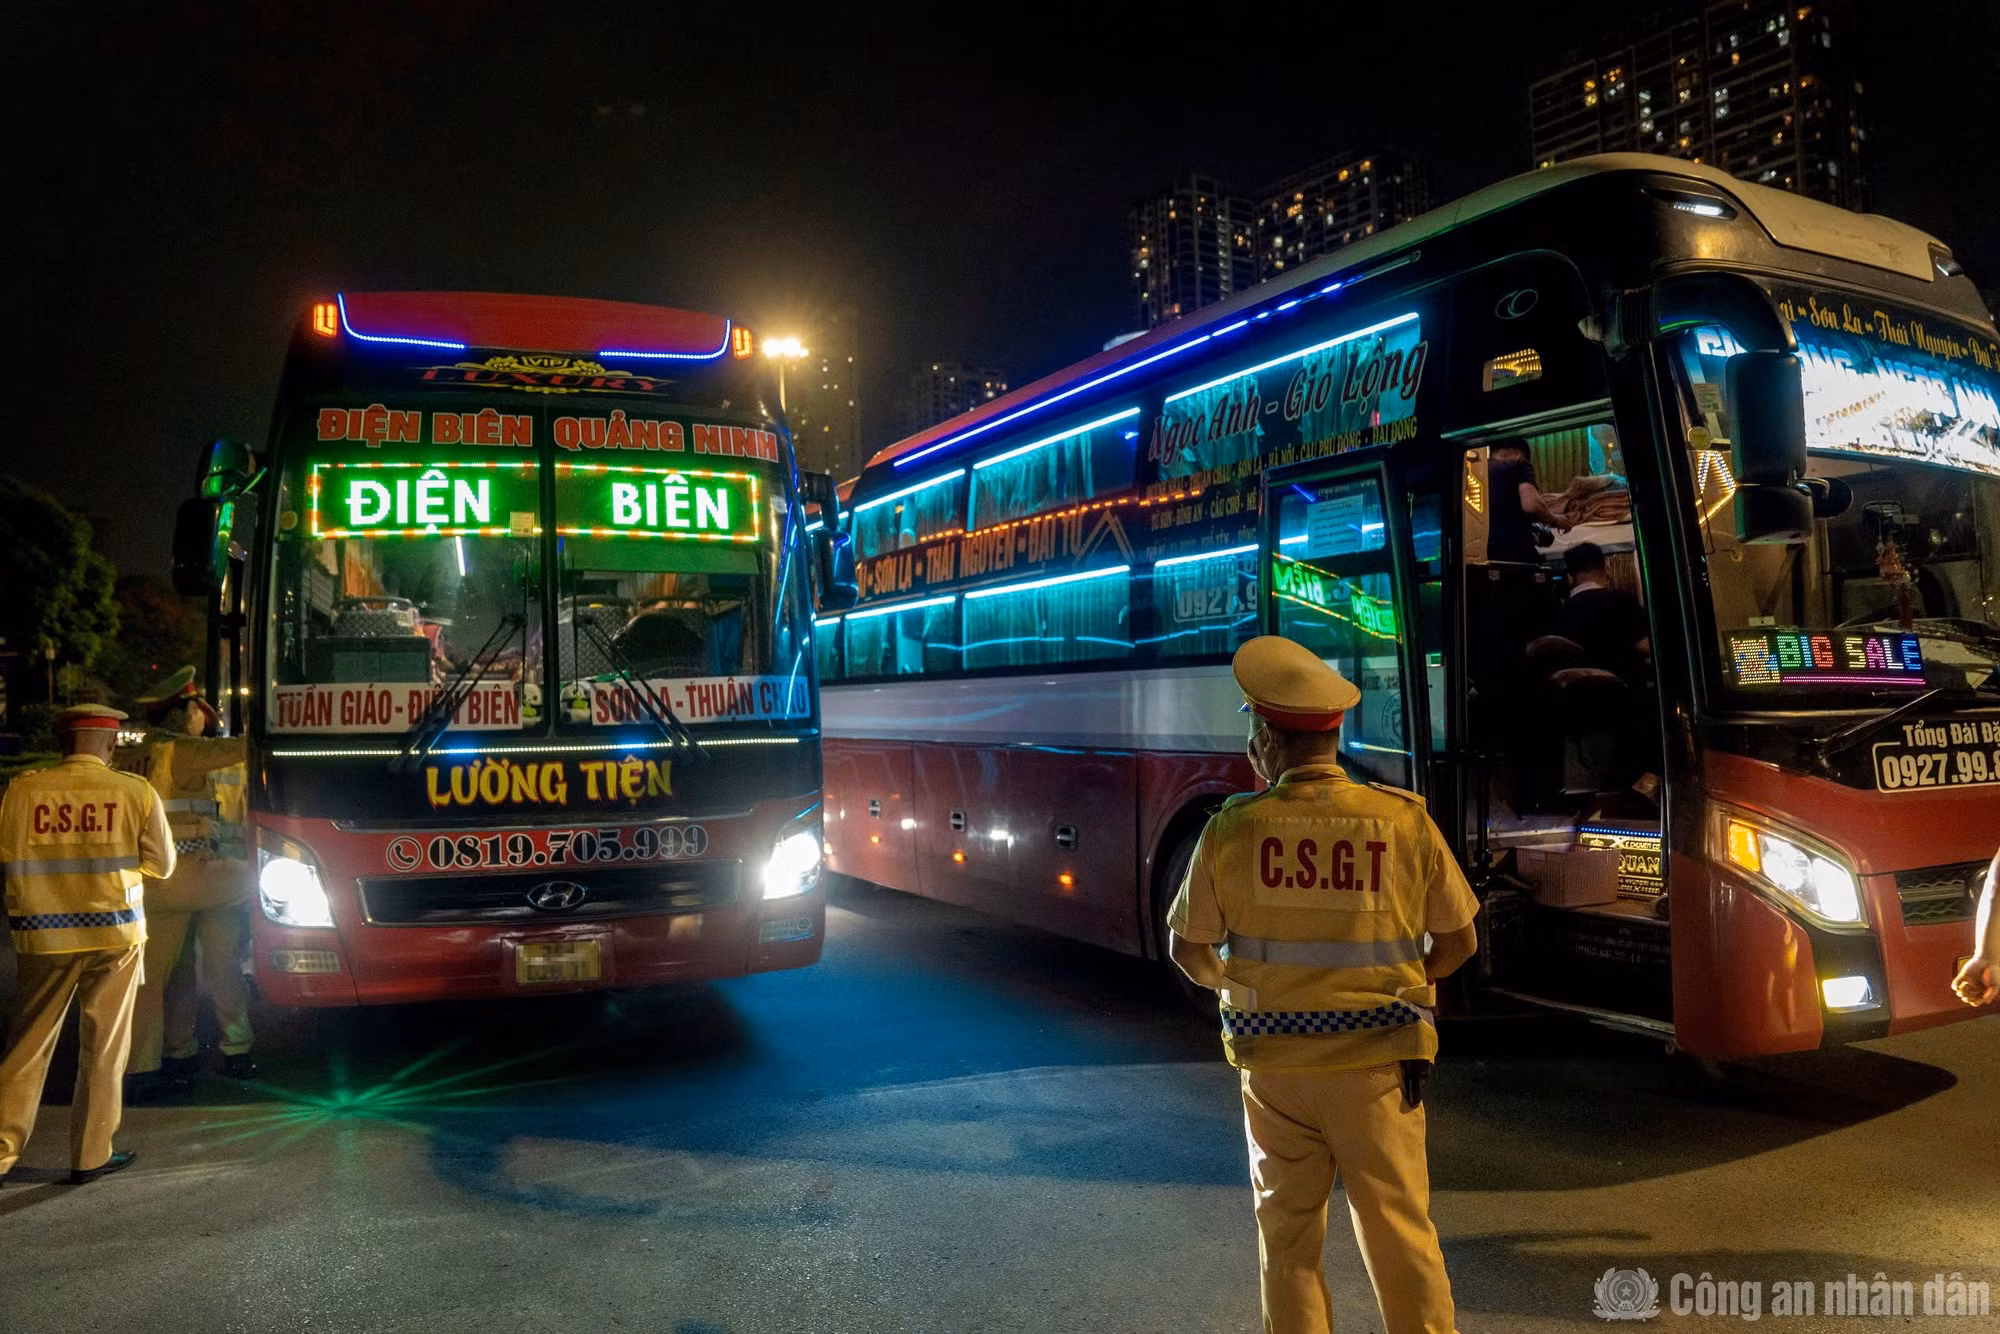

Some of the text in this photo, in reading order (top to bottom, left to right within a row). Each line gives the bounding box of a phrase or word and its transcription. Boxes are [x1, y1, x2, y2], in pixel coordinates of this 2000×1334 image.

[421, 367, 668, 391] LUXURY
[530, 356, 565, 368] VIP
[1207, 385, 1261, 443] Anh
[1283, 357, 1333, 422] Gió
[317, 403, 779, 463] ĐIỆN BIÊN QUẢNG NINH
[611, 474, 730, 530] BIÊN
[1776, 635, 1922, 670] BIG SALE
[276, 684, 333, 728] TUẦN
[340, 684, 393, 725] GIÁO
[468, 684, 520, 725] BIÊN
[685, 676, 755, 722] THUẬN
[1902, 720, 1949, 749] Tổng
[1950, 723, 1980, 745] Đài
[426, 757, 568, 806] LƯỜNG
[34, 803, 117, 835] C.S.G.T
[428, 824, 710, 870] 0819.705.999
[1261, 836, 1387, 892] C.S.G.T
